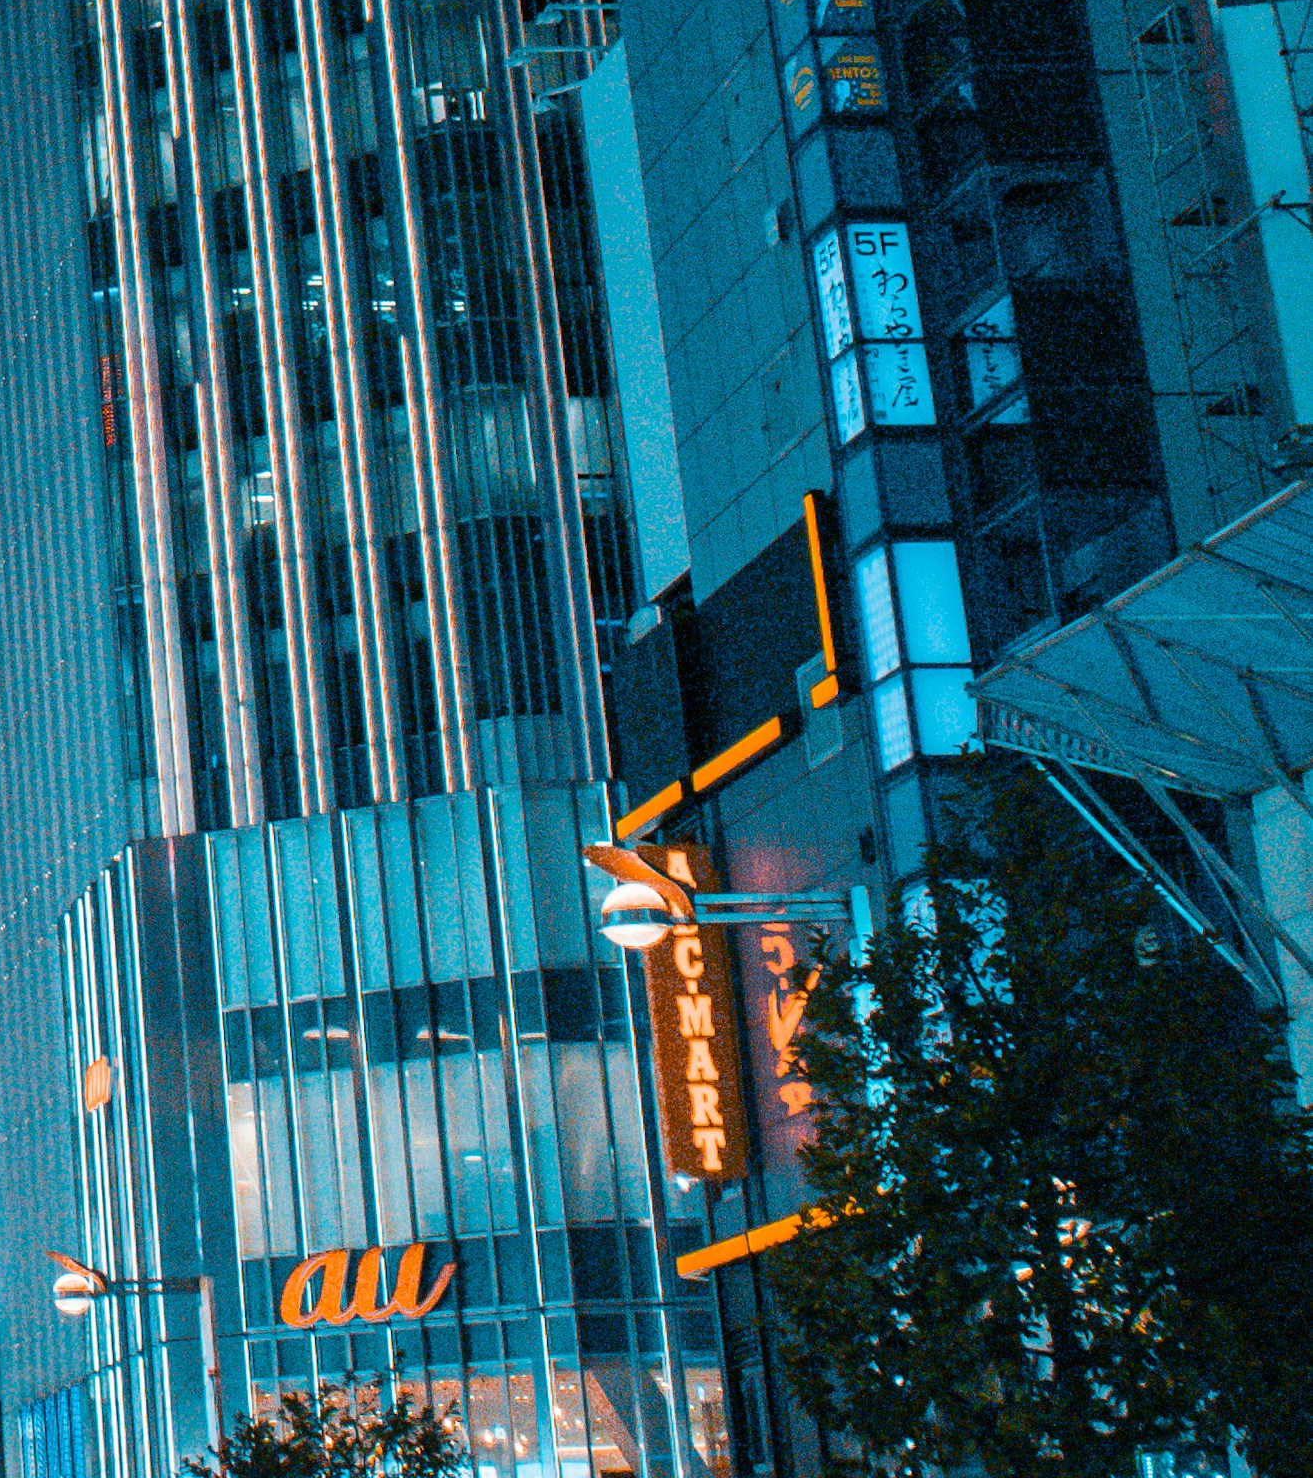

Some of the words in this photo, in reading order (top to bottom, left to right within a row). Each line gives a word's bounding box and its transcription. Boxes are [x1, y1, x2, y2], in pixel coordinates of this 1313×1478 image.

[854, 231, 899, 257] 5F
[665, 850, 727, 1173] AC-MART
[280, 1241, 458, 1328] au
